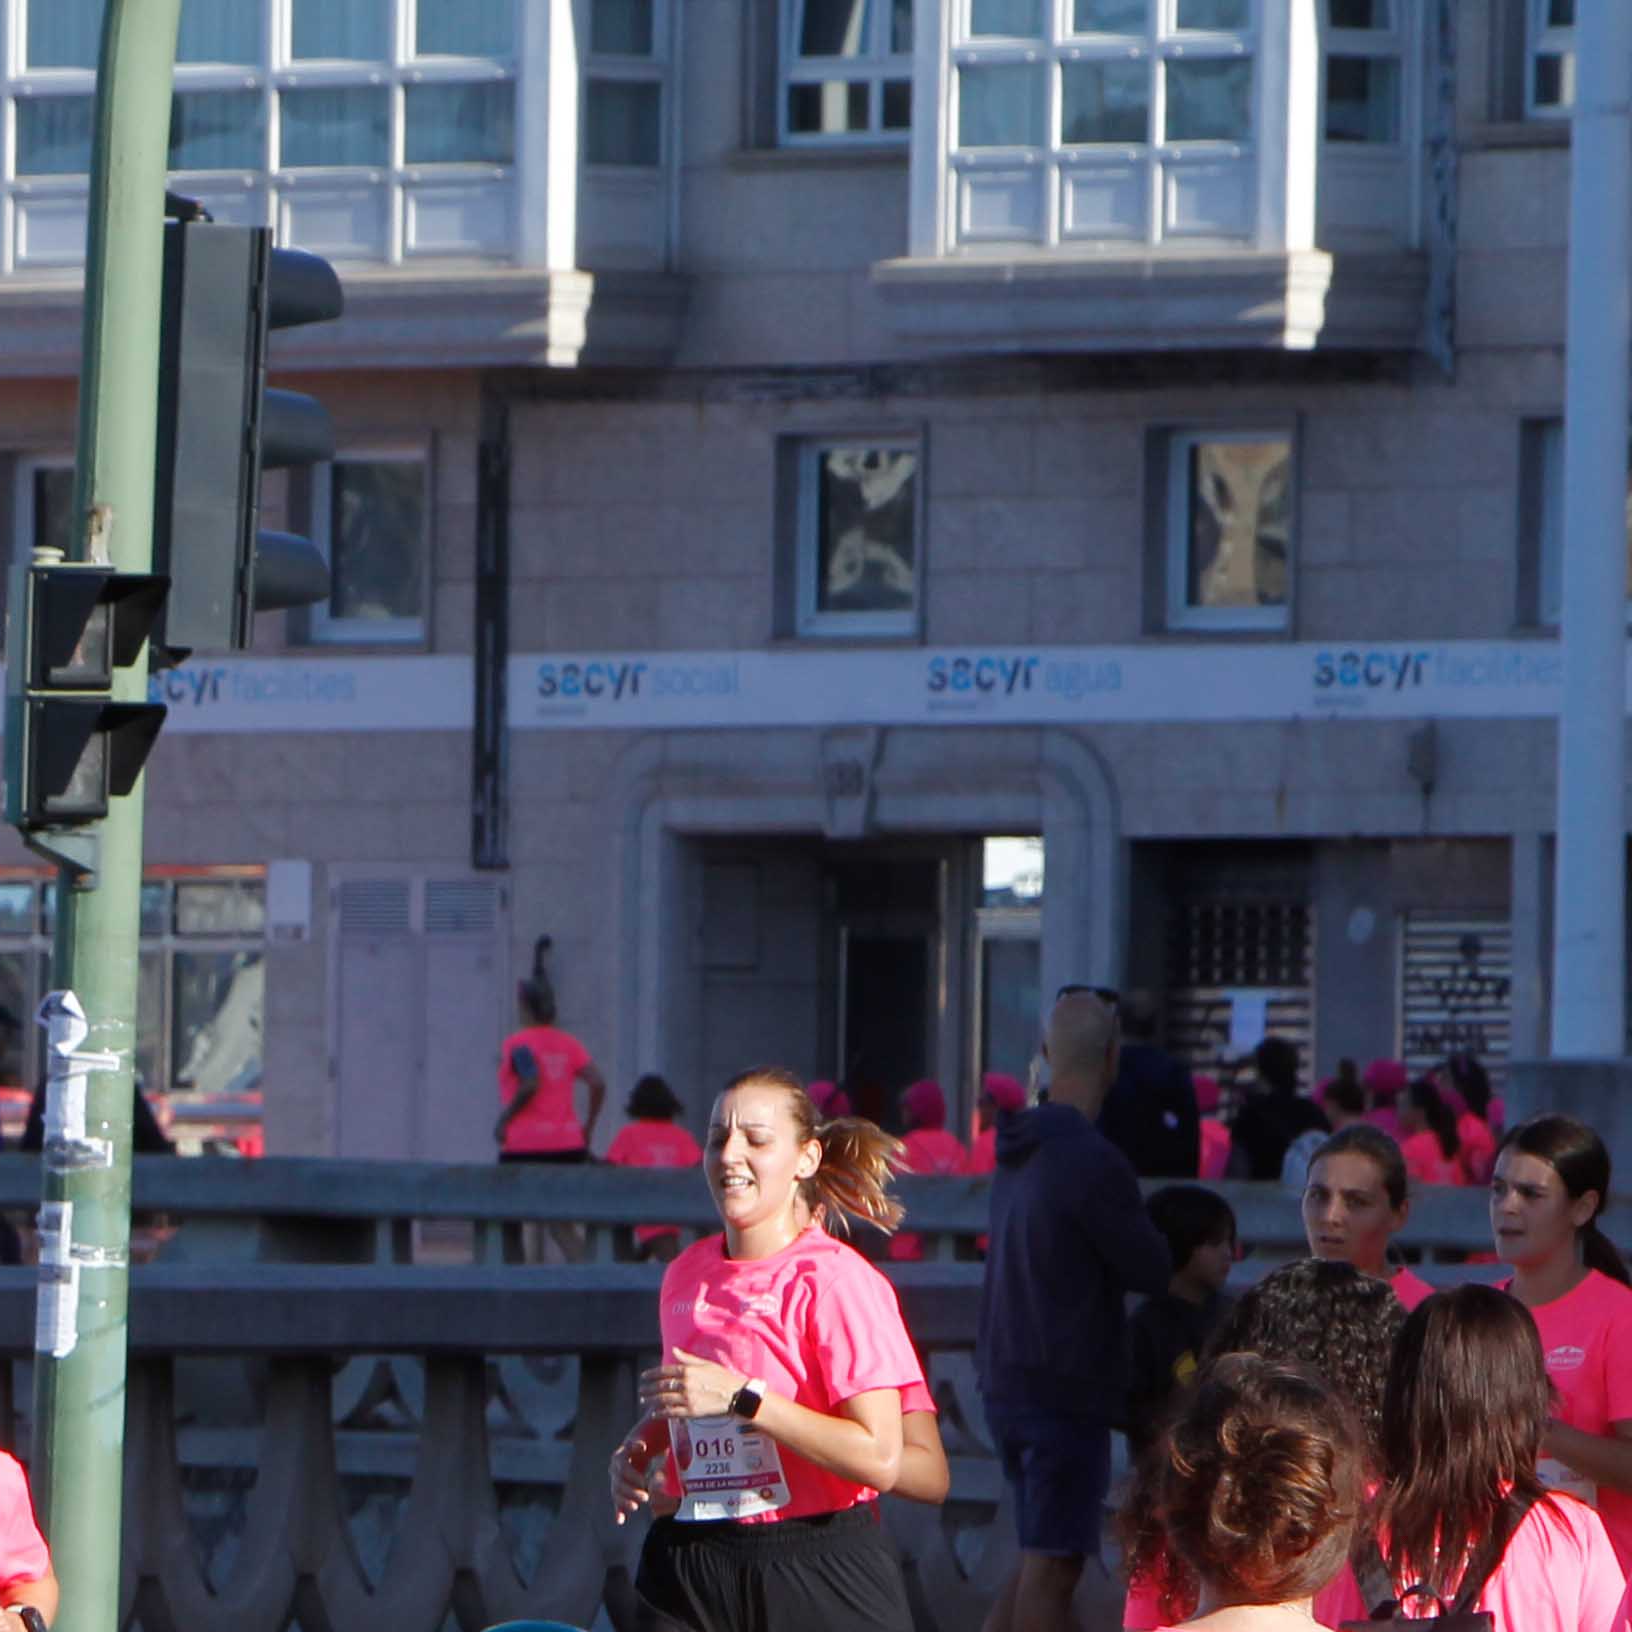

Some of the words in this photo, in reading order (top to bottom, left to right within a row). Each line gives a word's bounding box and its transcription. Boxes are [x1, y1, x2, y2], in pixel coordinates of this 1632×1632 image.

[538, 662, 648, 700] sacyr
[928, 656, 1040, 695] sacyr
[1313, 651, 1430, 690] sacyr
[696, 1438, 735, 1457] 016
